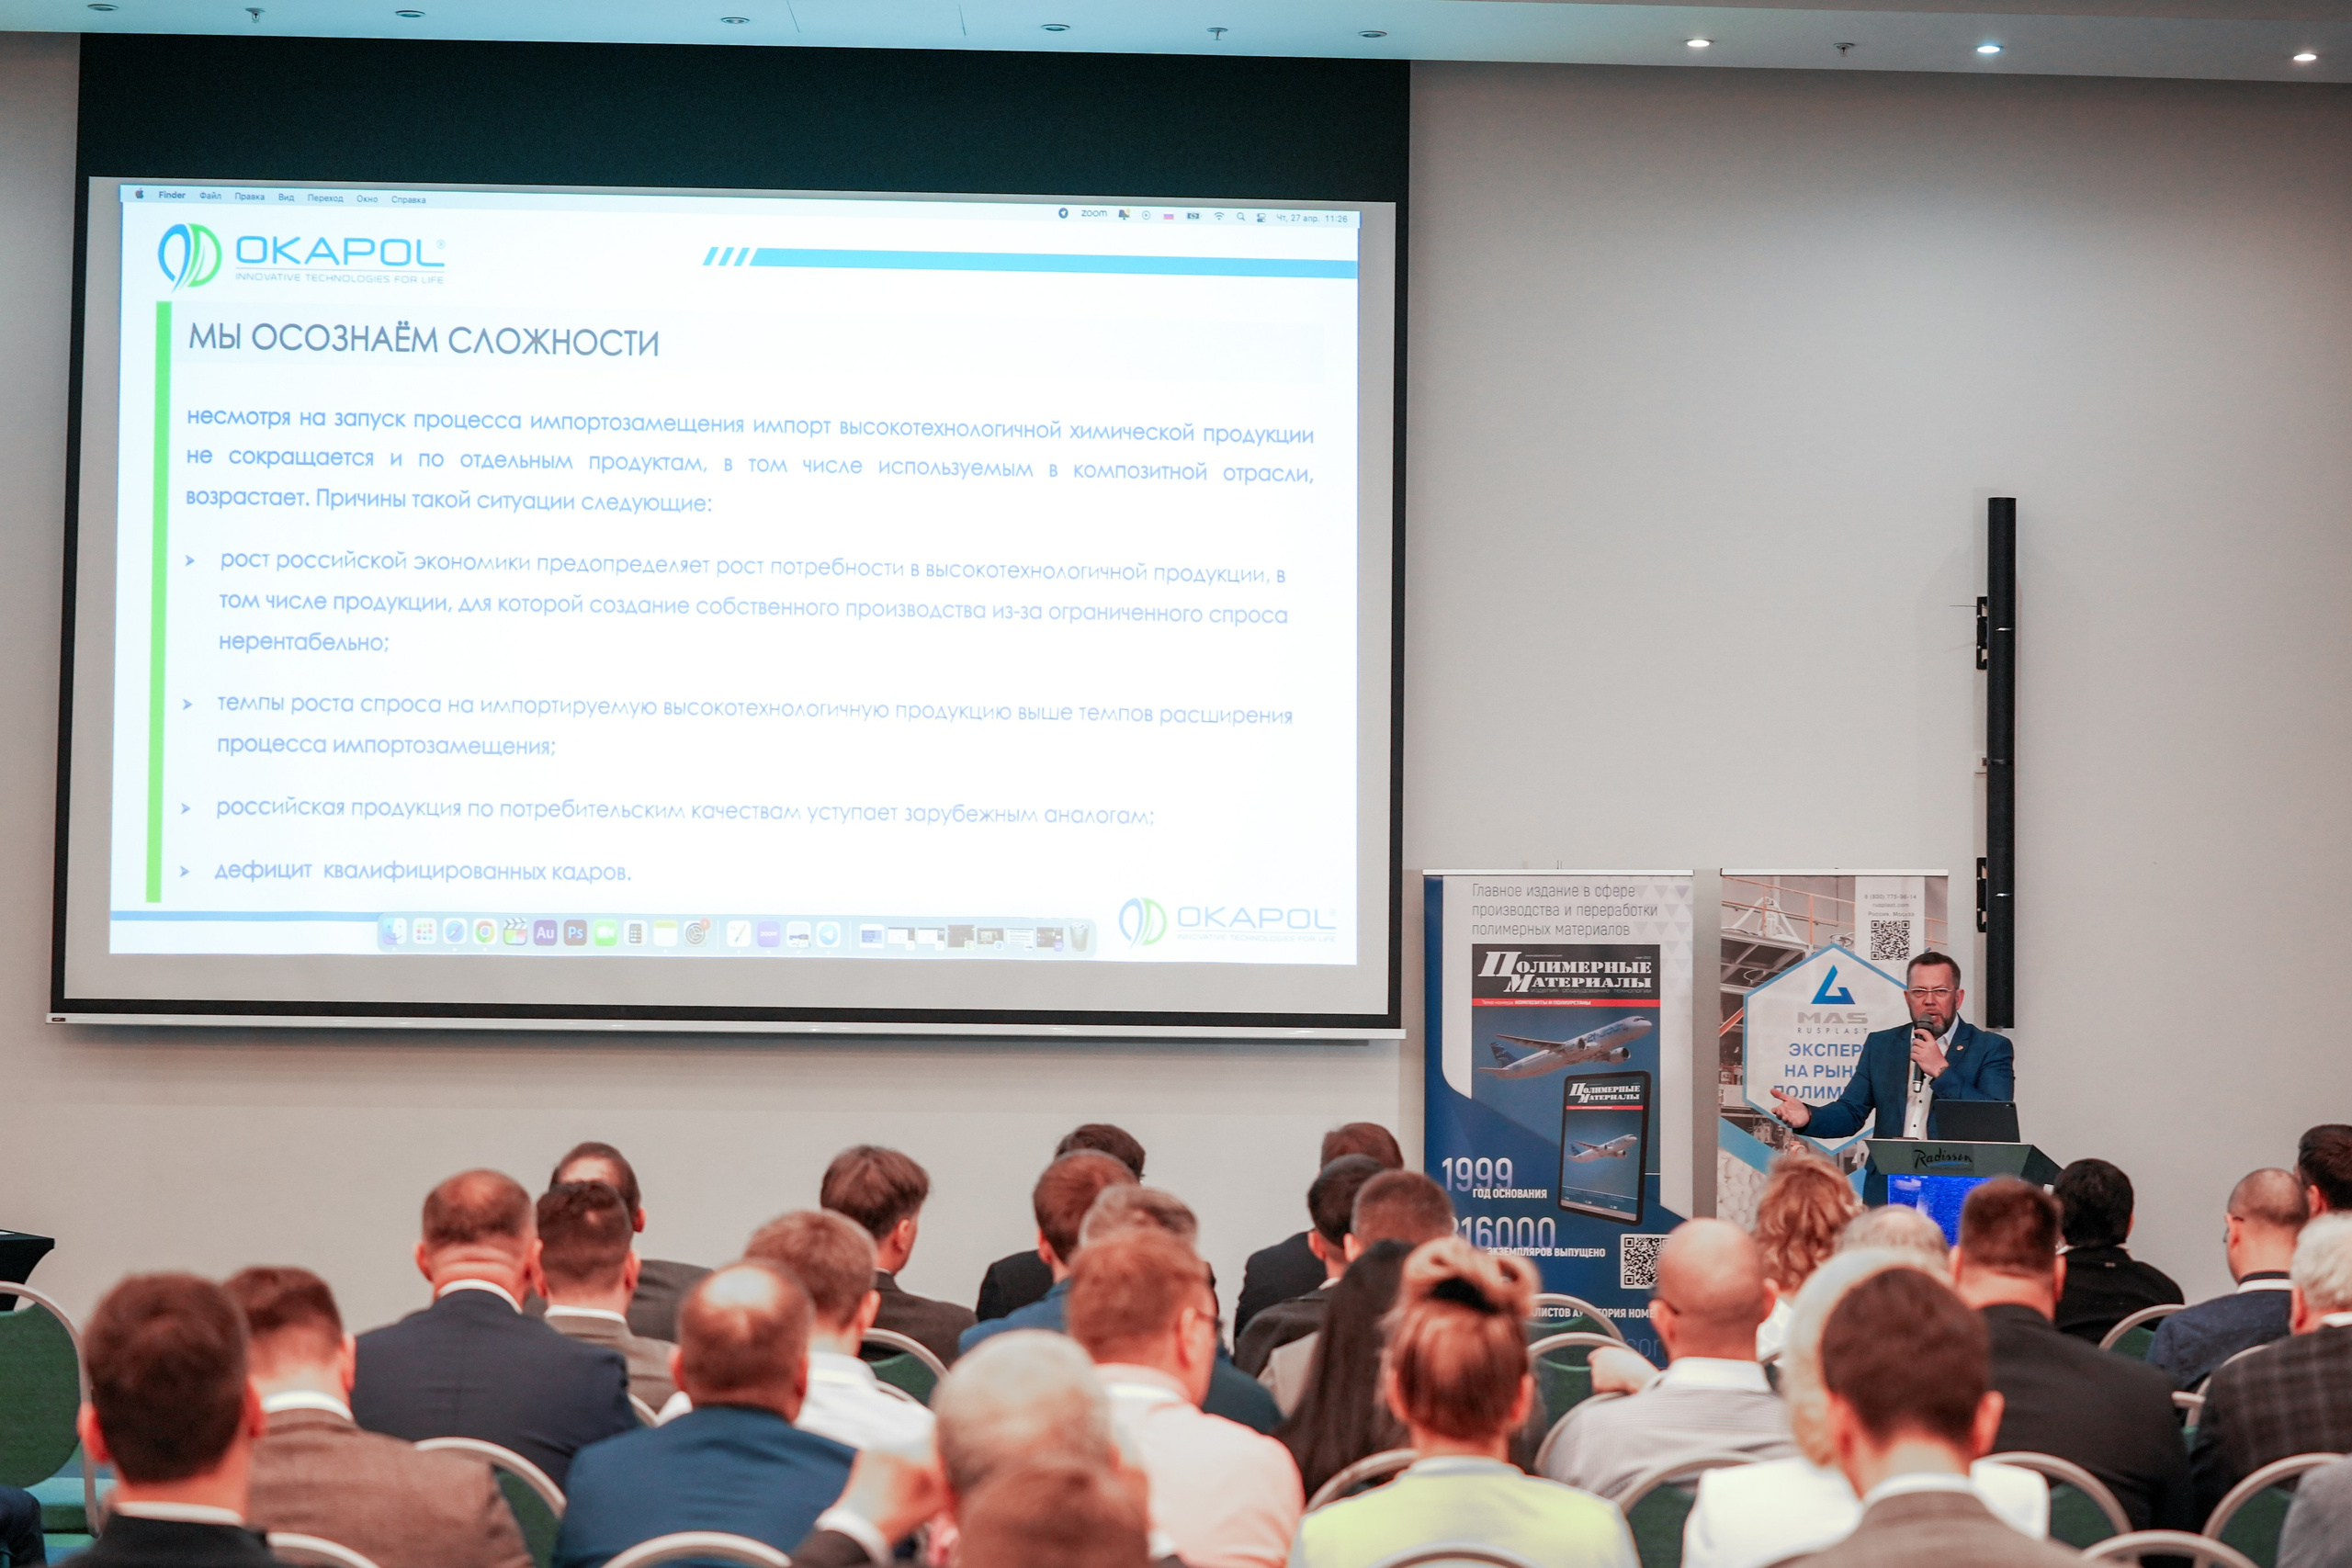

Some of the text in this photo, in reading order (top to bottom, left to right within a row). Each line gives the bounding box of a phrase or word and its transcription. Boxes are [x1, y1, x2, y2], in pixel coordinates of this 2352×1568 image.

[158, 190, 426, 206] Finder Файл Правка Вид Переход Окно Справка
[1081, 209, 1107, 219] zoom
[1291, 214, 1301, 222] 27
[1325, 215, 1348, 223] 11:26
[236, 272, 445, 285] INNOVATIVE TECHNOLOGIES FOR LIFE
[188, 320, 659, 357] МЫ ОСОЗНАЁМ СЛОЖНОСТИ
[187, 409, 1314, 447] несмотря на запуск процесса импортозамещения импорт высокотехнологичной химической продукции
[187, 448, 1314, 486] не сокращается и по отдельным продуктам, в том числе используемым в композитной отрасли,
[186, 488, 712, 515] возрастает. Причины такой ситуации следующие:
[220, 550, 1286, 587] рост российской экономики предопределяет рост потребности в высокотехнологичной продукции, в
[219, 593, 1288, 627] том числе продукции, для которой создание собственного производства из-за ограниченного спроса
[219, 631, 390, 654] нерентабельно;
[217, 695, 1294, 728] темпы роста спроса на импортируемую высокотехнологичную продукцию выше темпов расширения
[217, 737, 556, 758] процесса импортозамещения;
[216, 796, 1155, 827] российская продукция по потребительским качествам уступает зарубежным аналогам;
[214, 859, 632, 886] дефицит квалифицированных кадров.
[1472, 883, 1635, 899] Главное издание в сфере
[1472, 903, 1658, 919] производства и переработки
[537, 927, 554, 939] Au
[568, 927, 583, 941] Ps
[1177, 933, 1227, 942] INNOVATIVE
[1230, 934, 1295, 942] TECHNOLOGIES
[1297, 935, 1316, 943] FOR
[1472, 924, 1631, 938] полимерных материалов
[1797, 1011, 1869, 1024] MAS
[1789, 1043, 1863, 1056] ЭКСПЕР
[1785, 1065, 1857, 1078] НА РЫН
[1442, 1157, 1513, 1191] 1999
[1472, 1189, 1548, 1200] ГОД ОСНОВАНИЯ
[1453, 1216, 1556, 1250] 16000
[1487, 1247, 1606, 1258] ЭКЗЕМПЛЯРОВ ВЫПУЩЕНО
